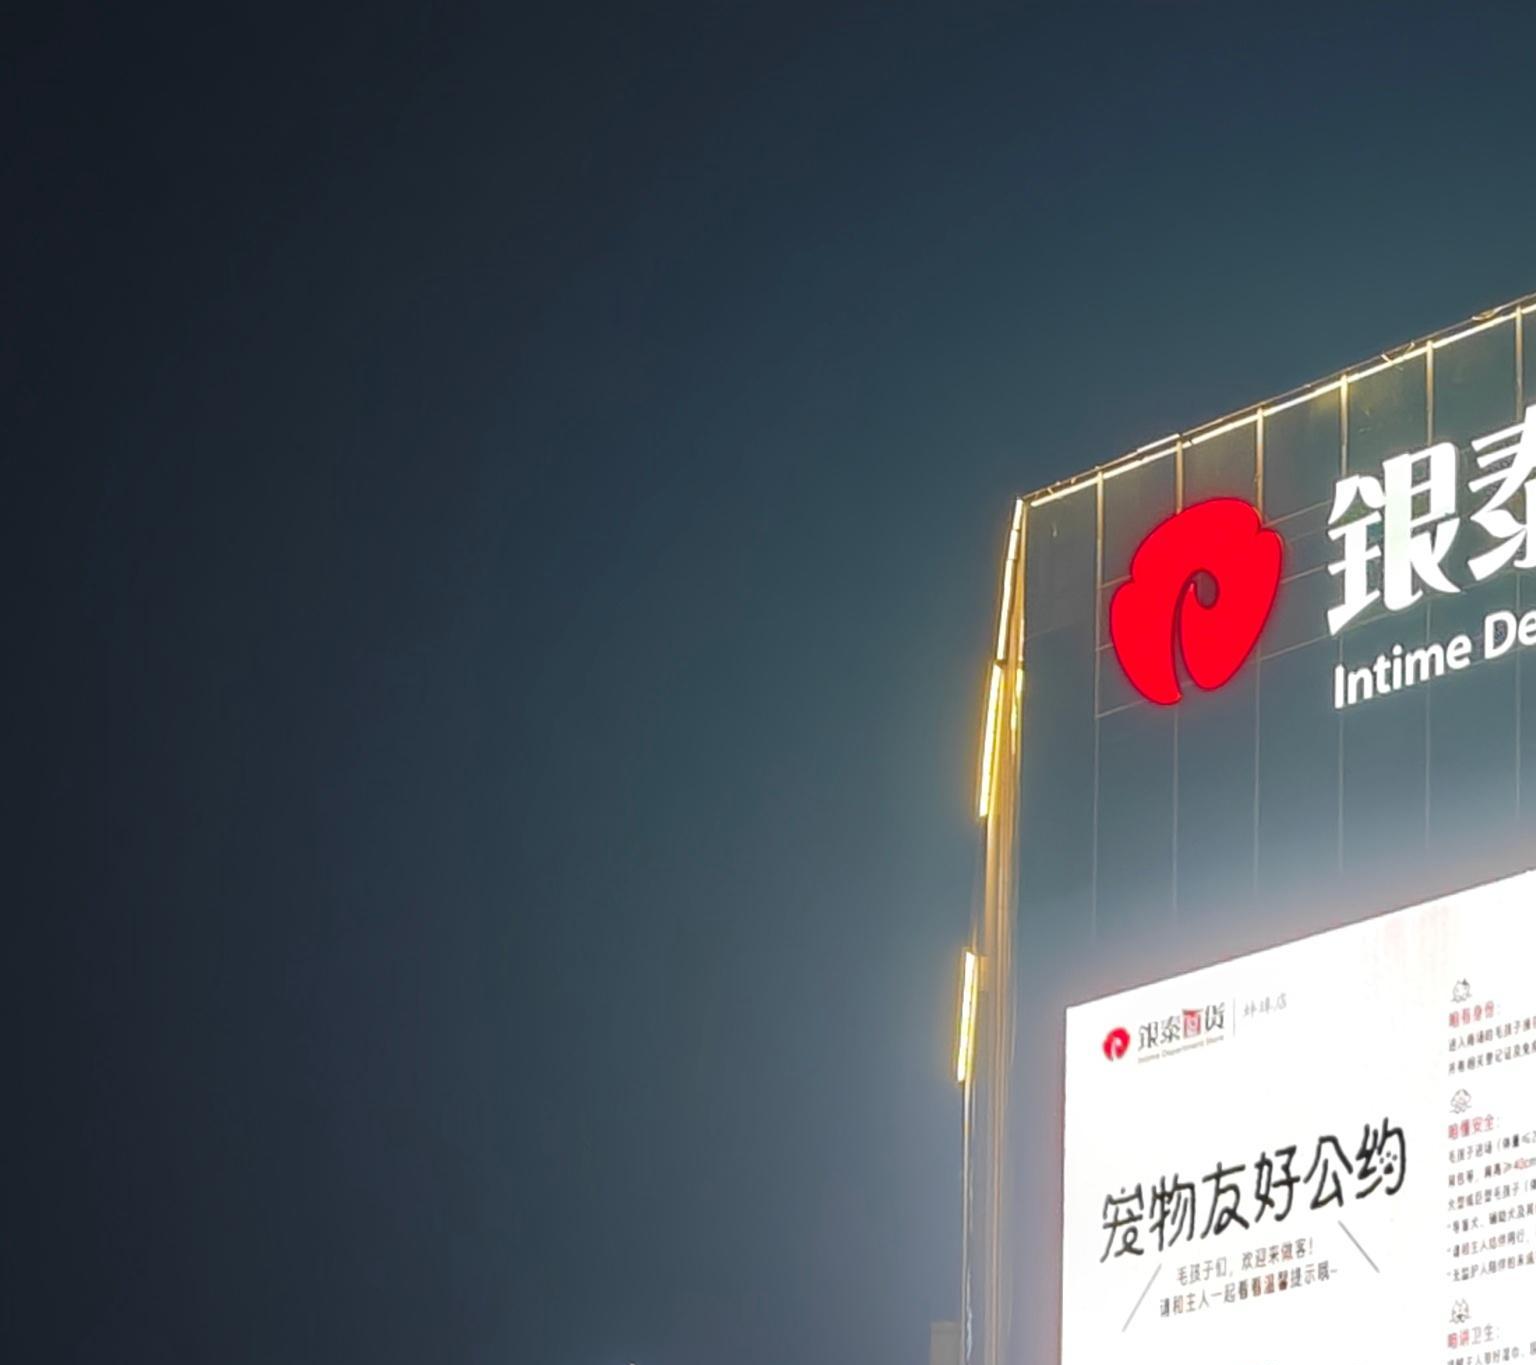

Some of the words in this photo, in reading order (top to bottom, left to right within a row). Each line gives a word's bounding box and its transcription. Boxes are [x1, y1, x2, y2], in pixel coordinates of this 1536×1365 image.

[1333, 634, 1473, 710] Intime
[1137, 1003, 1225, 1052] 银泰百货
[1099, 1116, 1406, 1262] 宠物友好公约
